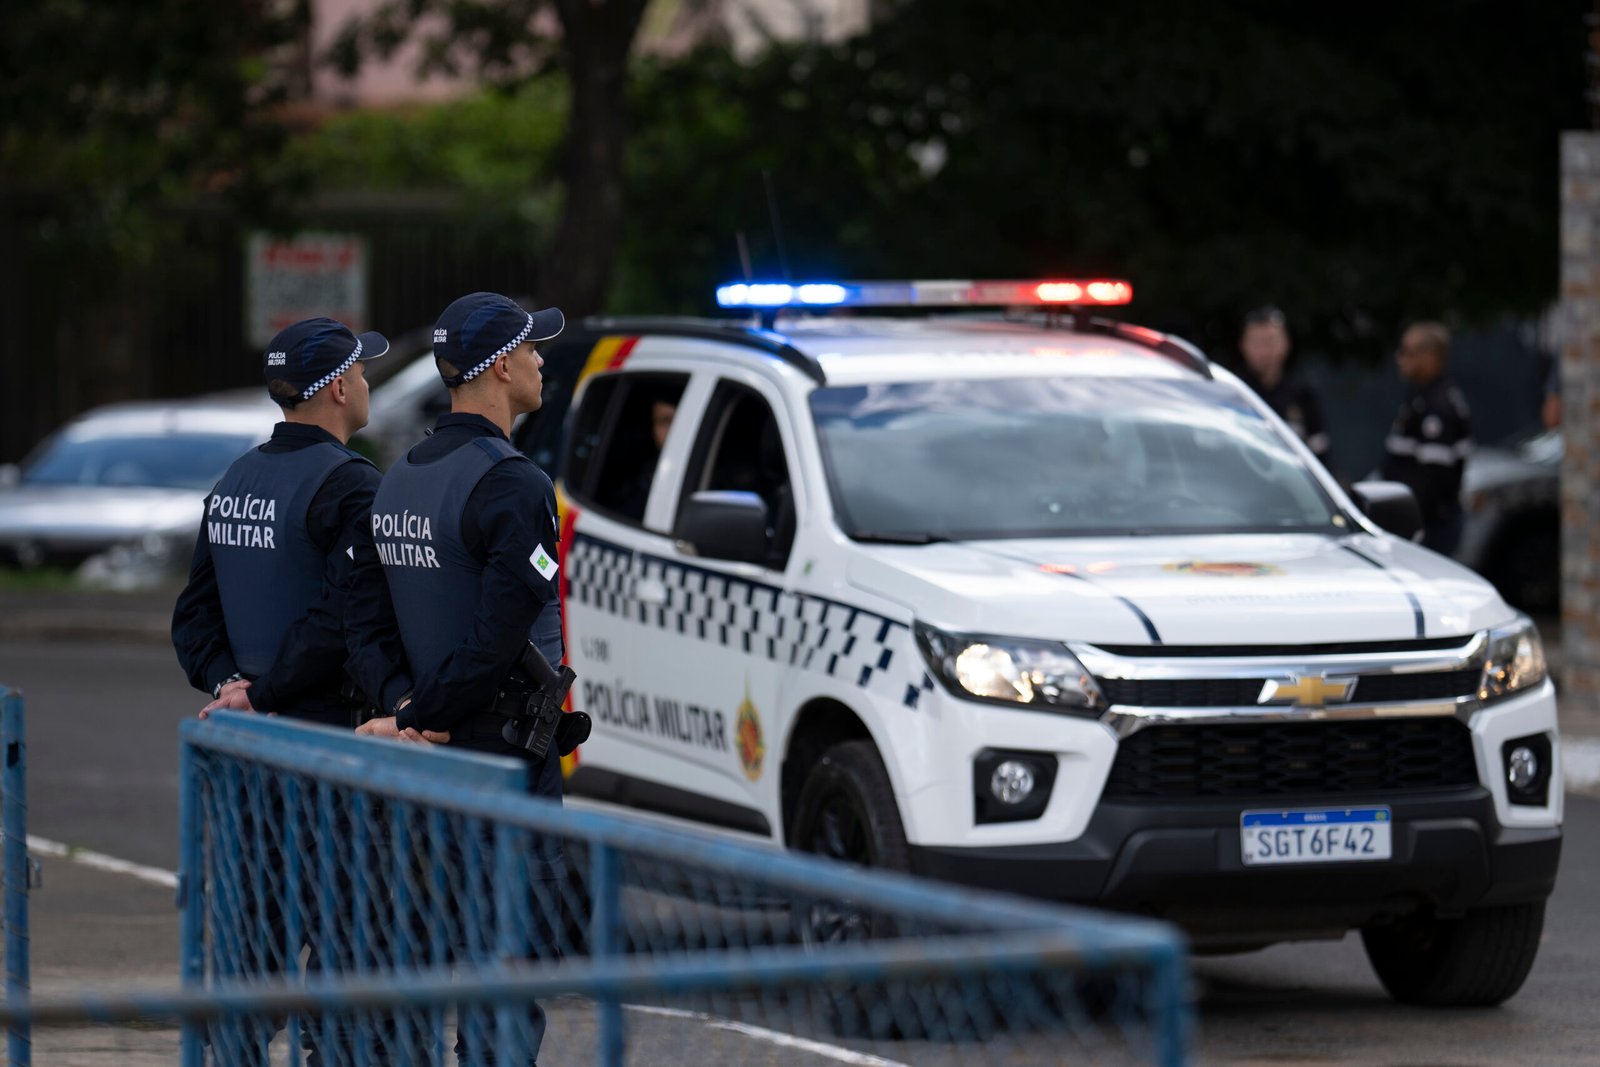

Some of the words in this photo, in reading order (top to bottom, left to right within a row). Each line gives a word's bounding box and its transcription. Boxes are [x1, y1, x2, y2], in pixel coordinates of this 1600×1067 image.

[208, 493, 276, 522] POLÍCIA
[207, 521, 276, 549] MILITAR
[372, 509, 433, 541] POLÍCIA
[375, 543, 441, 569] MILITAR
[653, 695, 728, 752] MILITAR
[1257, 826, 1376, 858] SGT6F42
